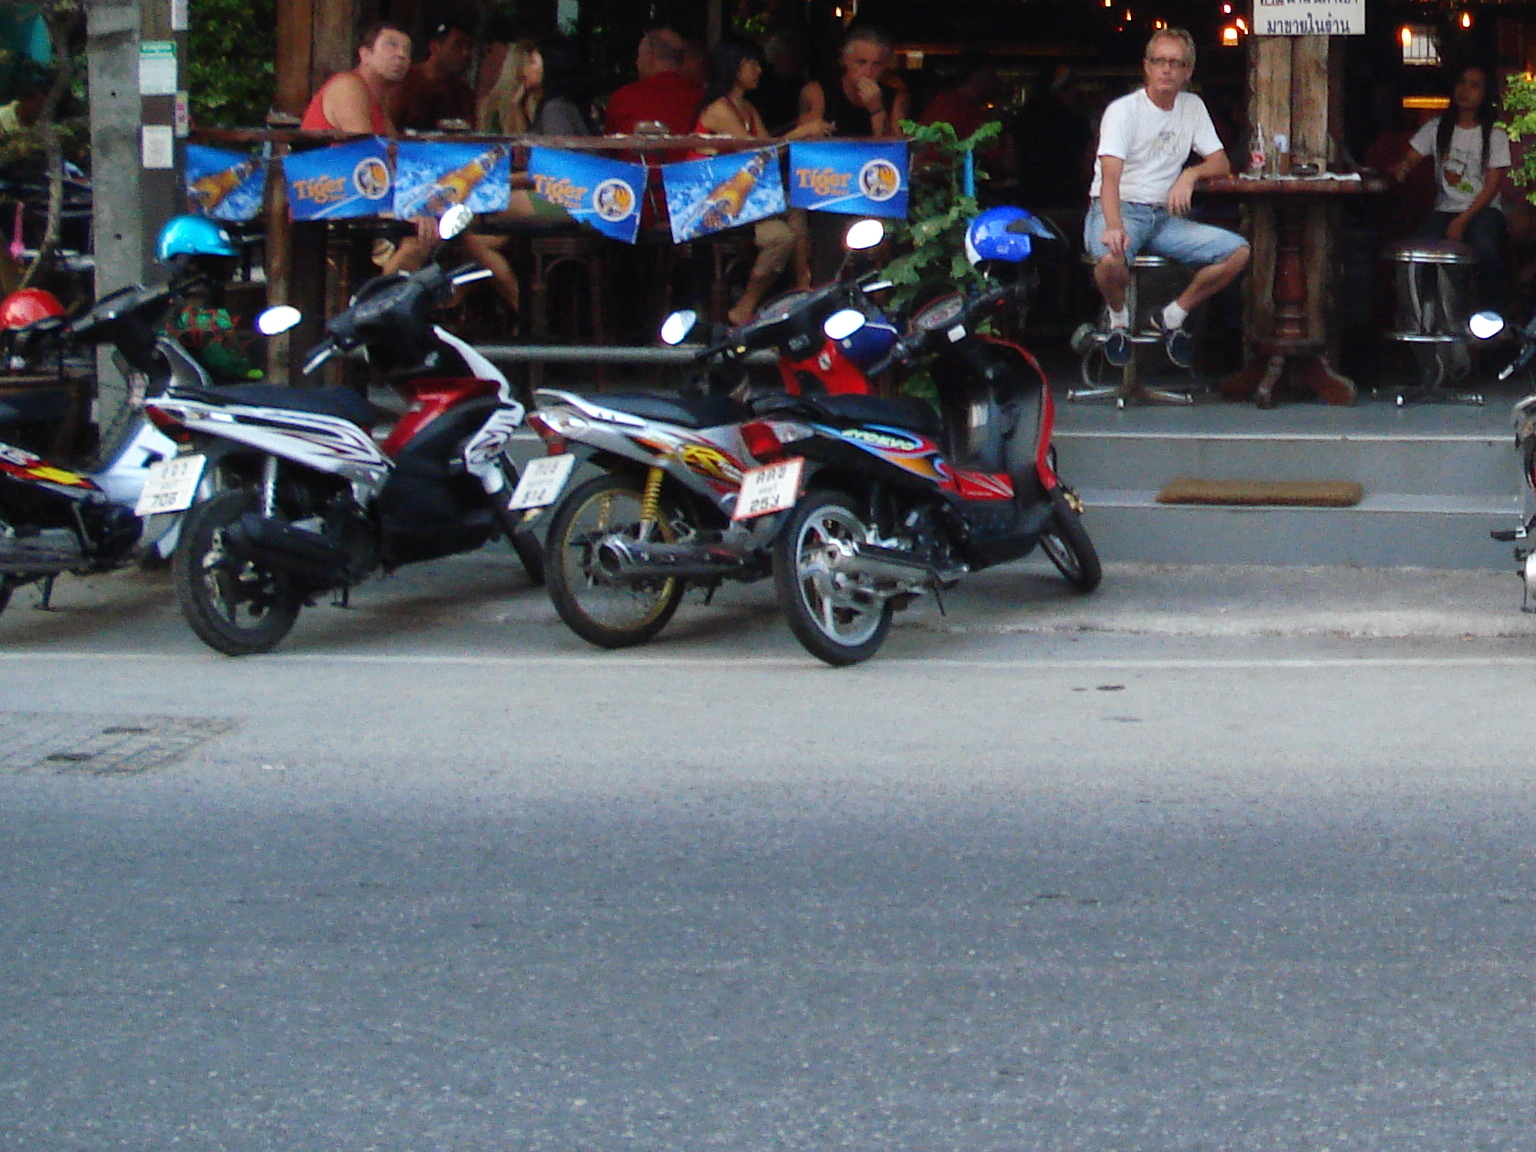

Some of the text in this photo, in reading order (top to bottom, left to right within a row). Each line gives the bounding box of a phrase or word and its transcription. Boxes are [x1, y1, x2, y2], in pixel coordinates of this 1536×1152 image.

[293, 174, 346, 202] Tiger
[533, 174, 587, 202] Tiger
[796, 168, 850, 193] Tiger
